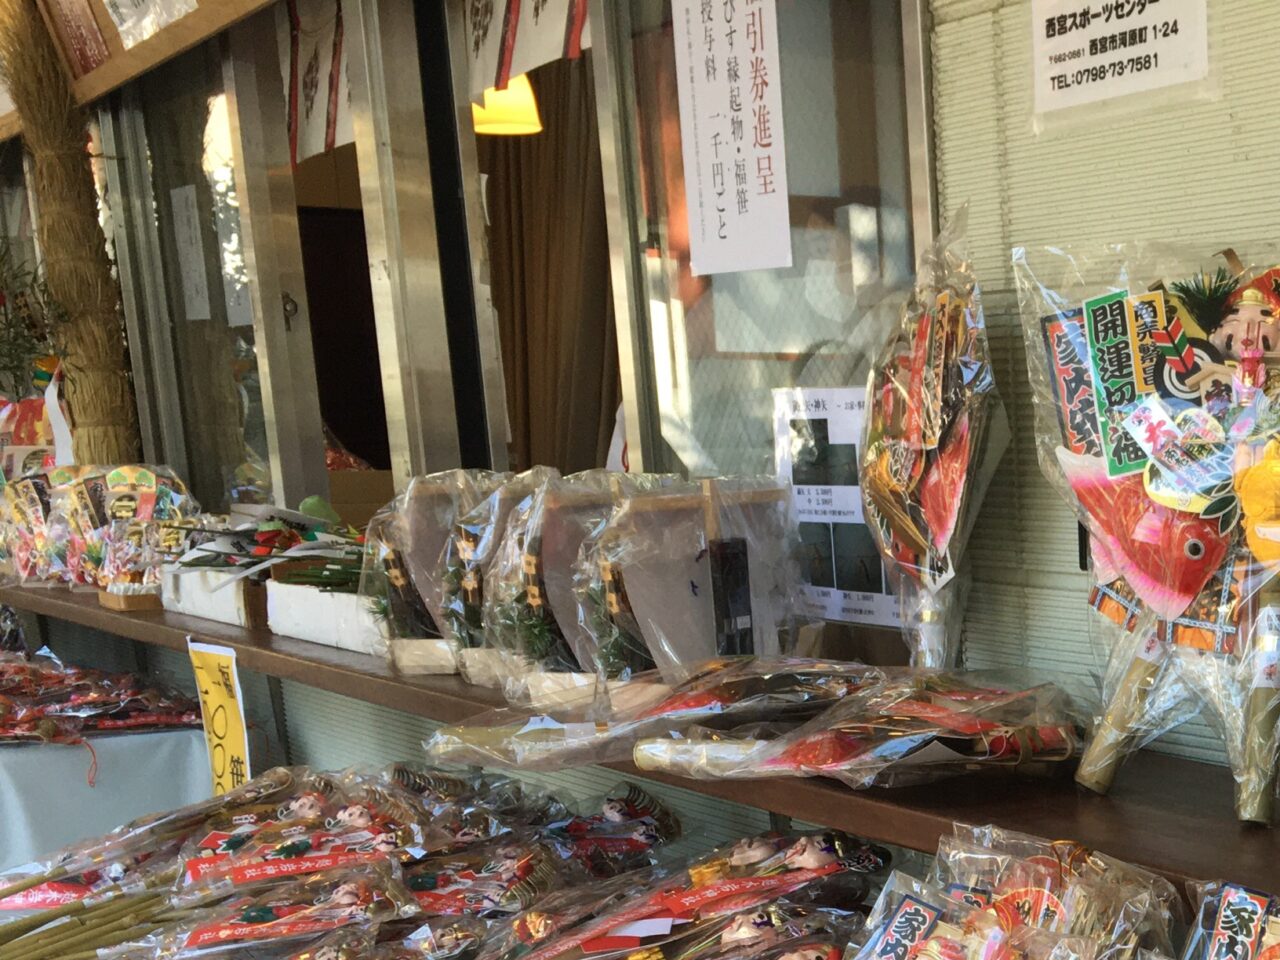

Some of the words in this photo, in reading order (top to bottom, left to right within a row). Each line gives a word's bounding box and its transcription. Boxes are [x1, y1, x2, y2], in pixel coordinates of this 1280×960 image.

[1089, 26, 1149, 56] 西宮市河原町
[745, 0, 777, 195] 引券進呈
